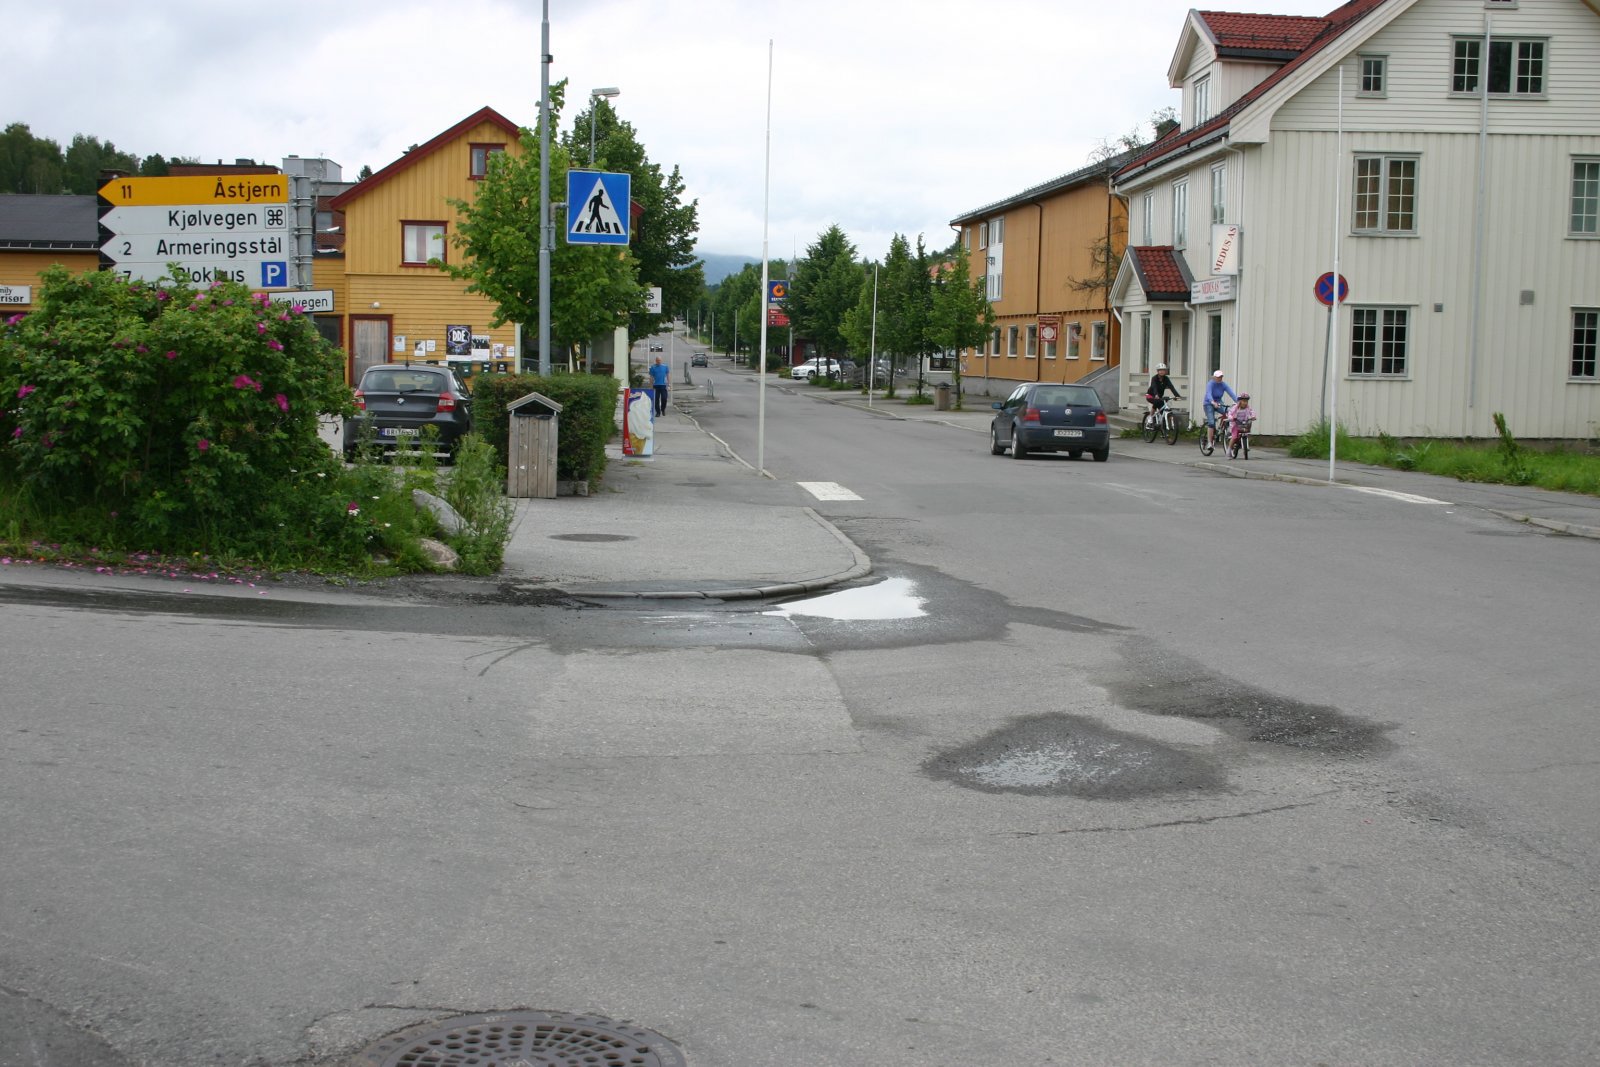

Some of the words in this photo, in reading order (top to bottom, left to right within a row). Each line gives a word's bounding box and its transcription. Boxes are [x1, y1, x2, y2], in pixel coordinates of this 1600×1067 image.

[121, 185, 132, 199] 11
[214, 177, 281, 202] Åstjern
[168, 210, 258, 230] Kjølvegen
[123, 241, 132, 256] 2
[156, 237, 282, 258] Armeringsstål
[1214, 239, 1232, 273] MEDUS
[1227, 226, 1236, 239] AS
[273, 296, 329, 310] Kølvegen
